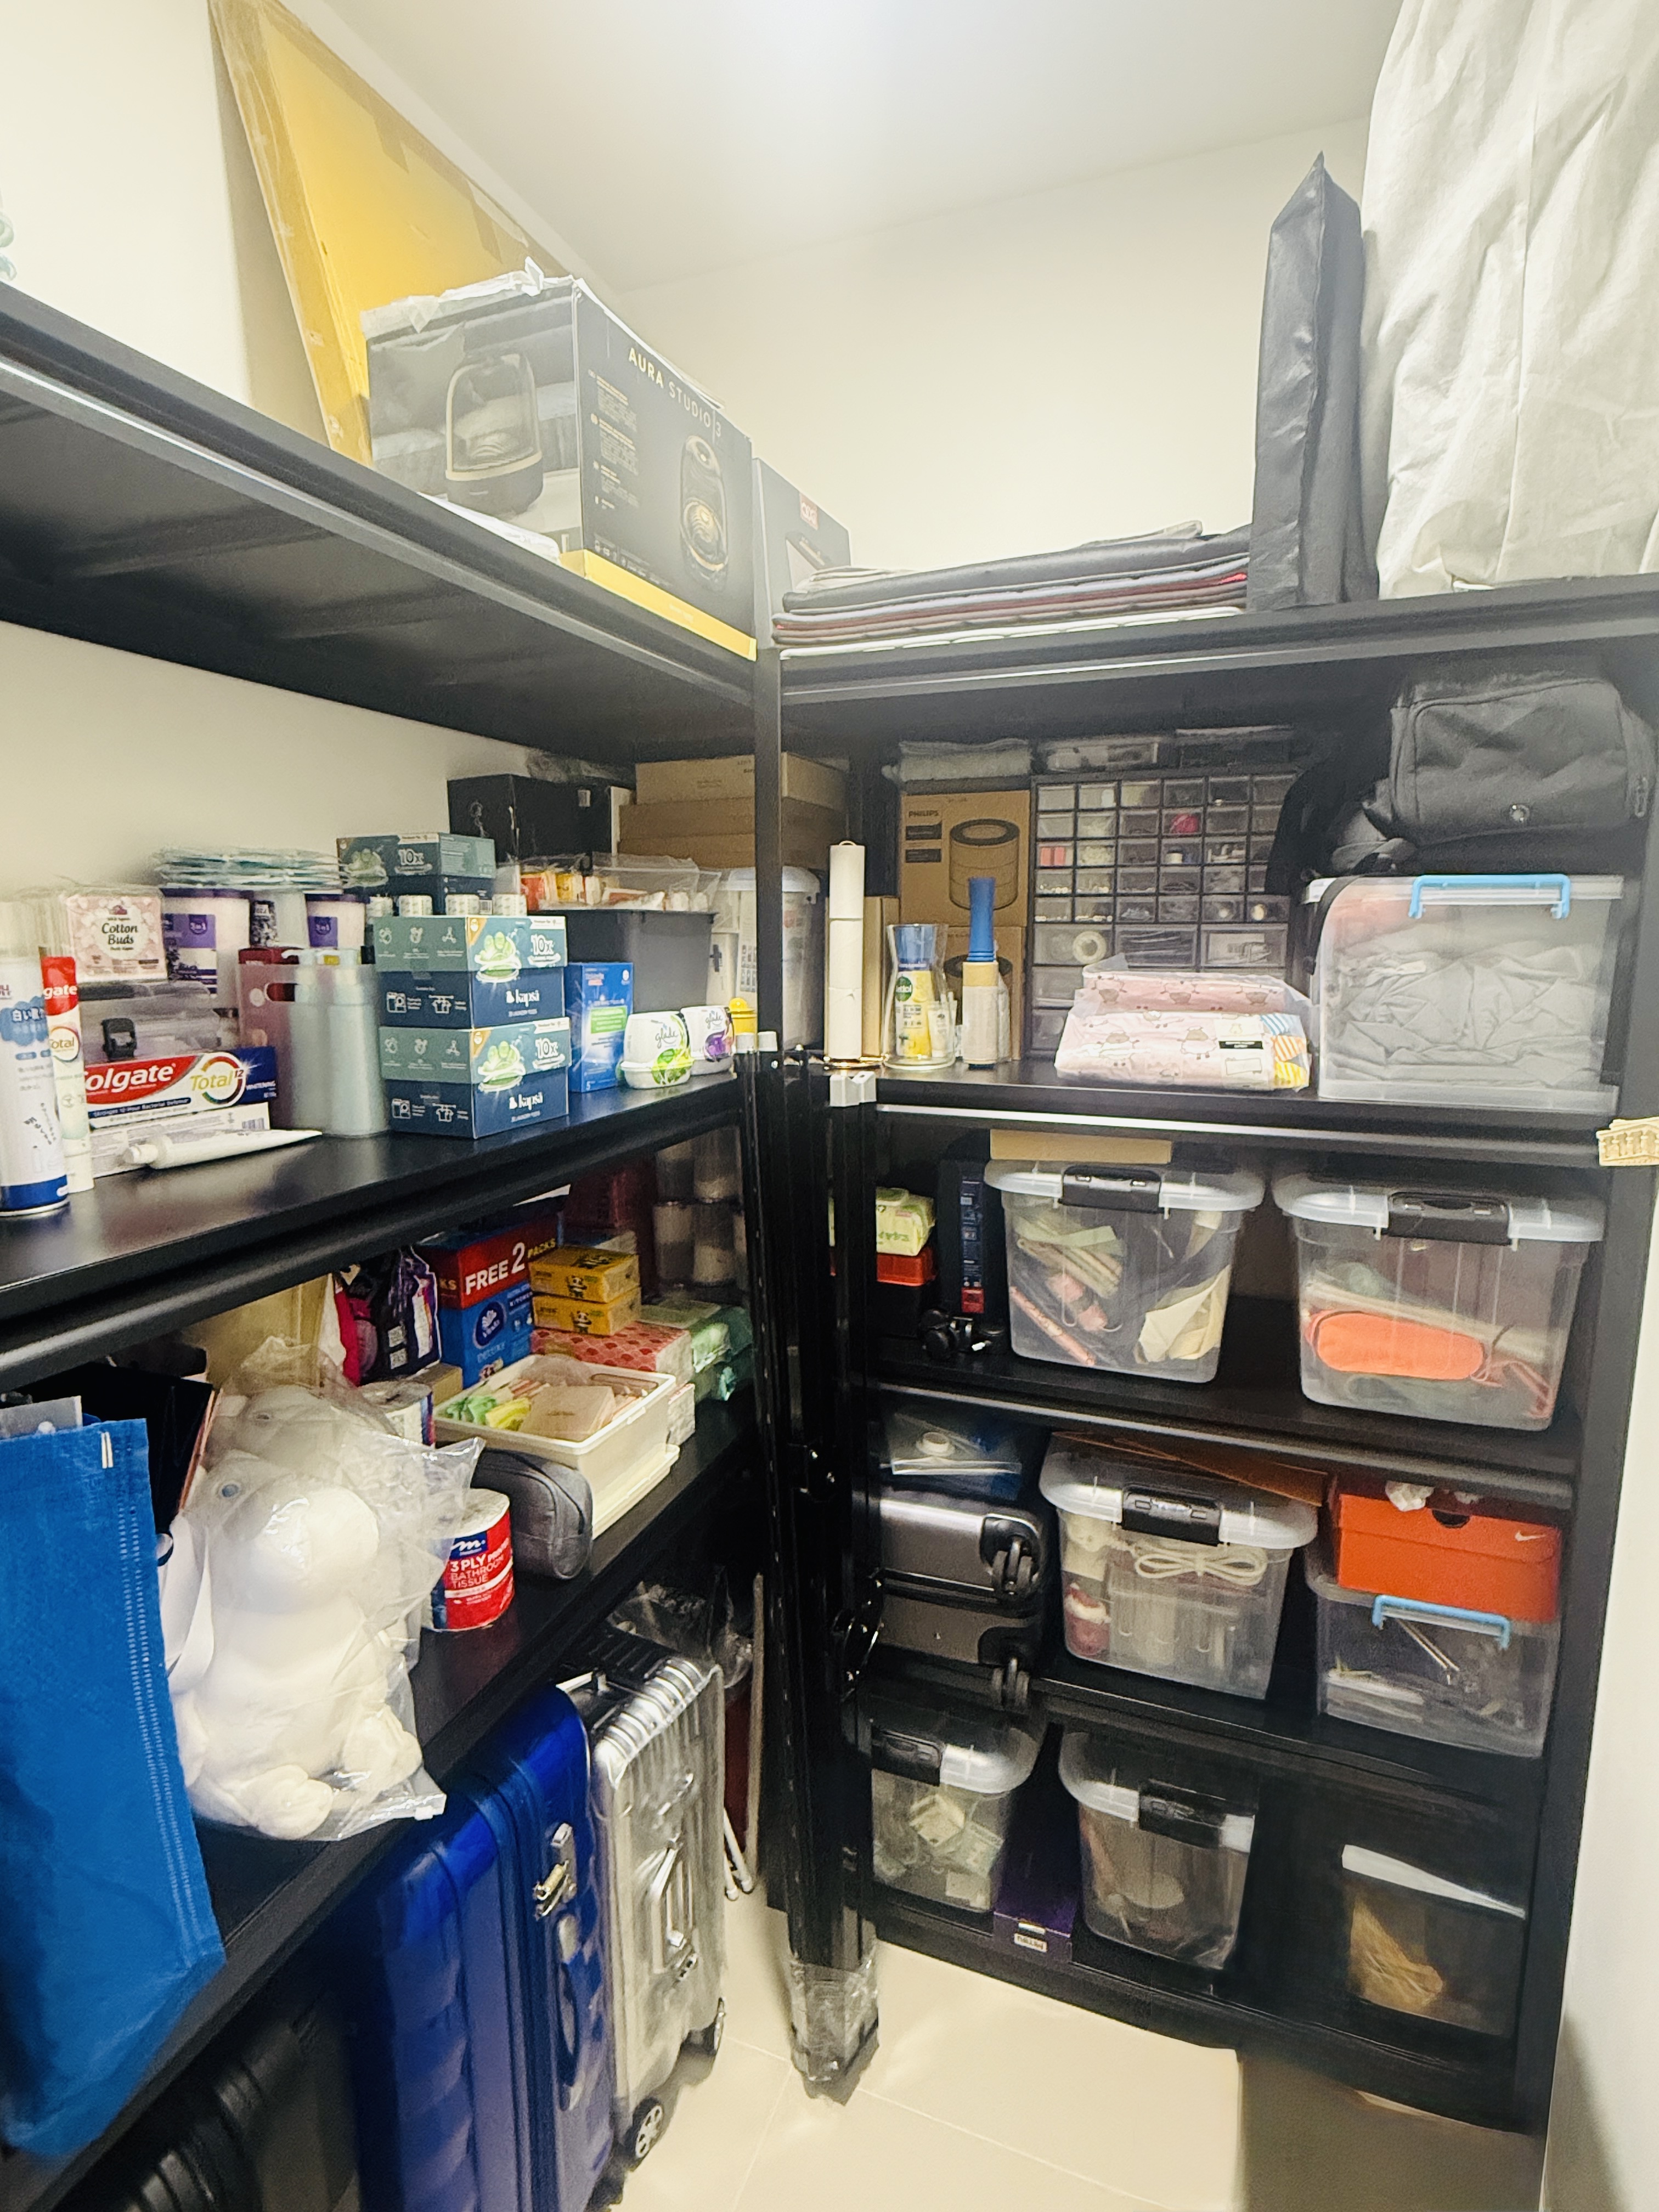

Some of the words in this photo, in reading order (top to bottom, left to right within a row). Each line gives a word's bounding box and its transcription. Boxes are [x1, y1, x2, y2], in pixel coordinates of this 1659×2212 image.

[629, 347, 664, 388] AURA
[669, 381, 711, 427] STUDIO
[101, 923, 138, 934] Cotton
[108, 934, 134, 945] Buds
[655, 1026, 679, 1049] glade
[535, 1038, 558, 1059] 10x
[190, 1071, 233, 1091] Total
[465, 1260, 509, 1295] FREE
[511, 1243, 526, 1274] 2
[527, 1238, 556, 1259] PACKS
[450, 1560, 460, 1572] 3
[461, 1554, 486, 1571] PLY
[451, 1555, 505, 1581] BATHROOM
[452, 1573, 489, 1589] TISSUE
